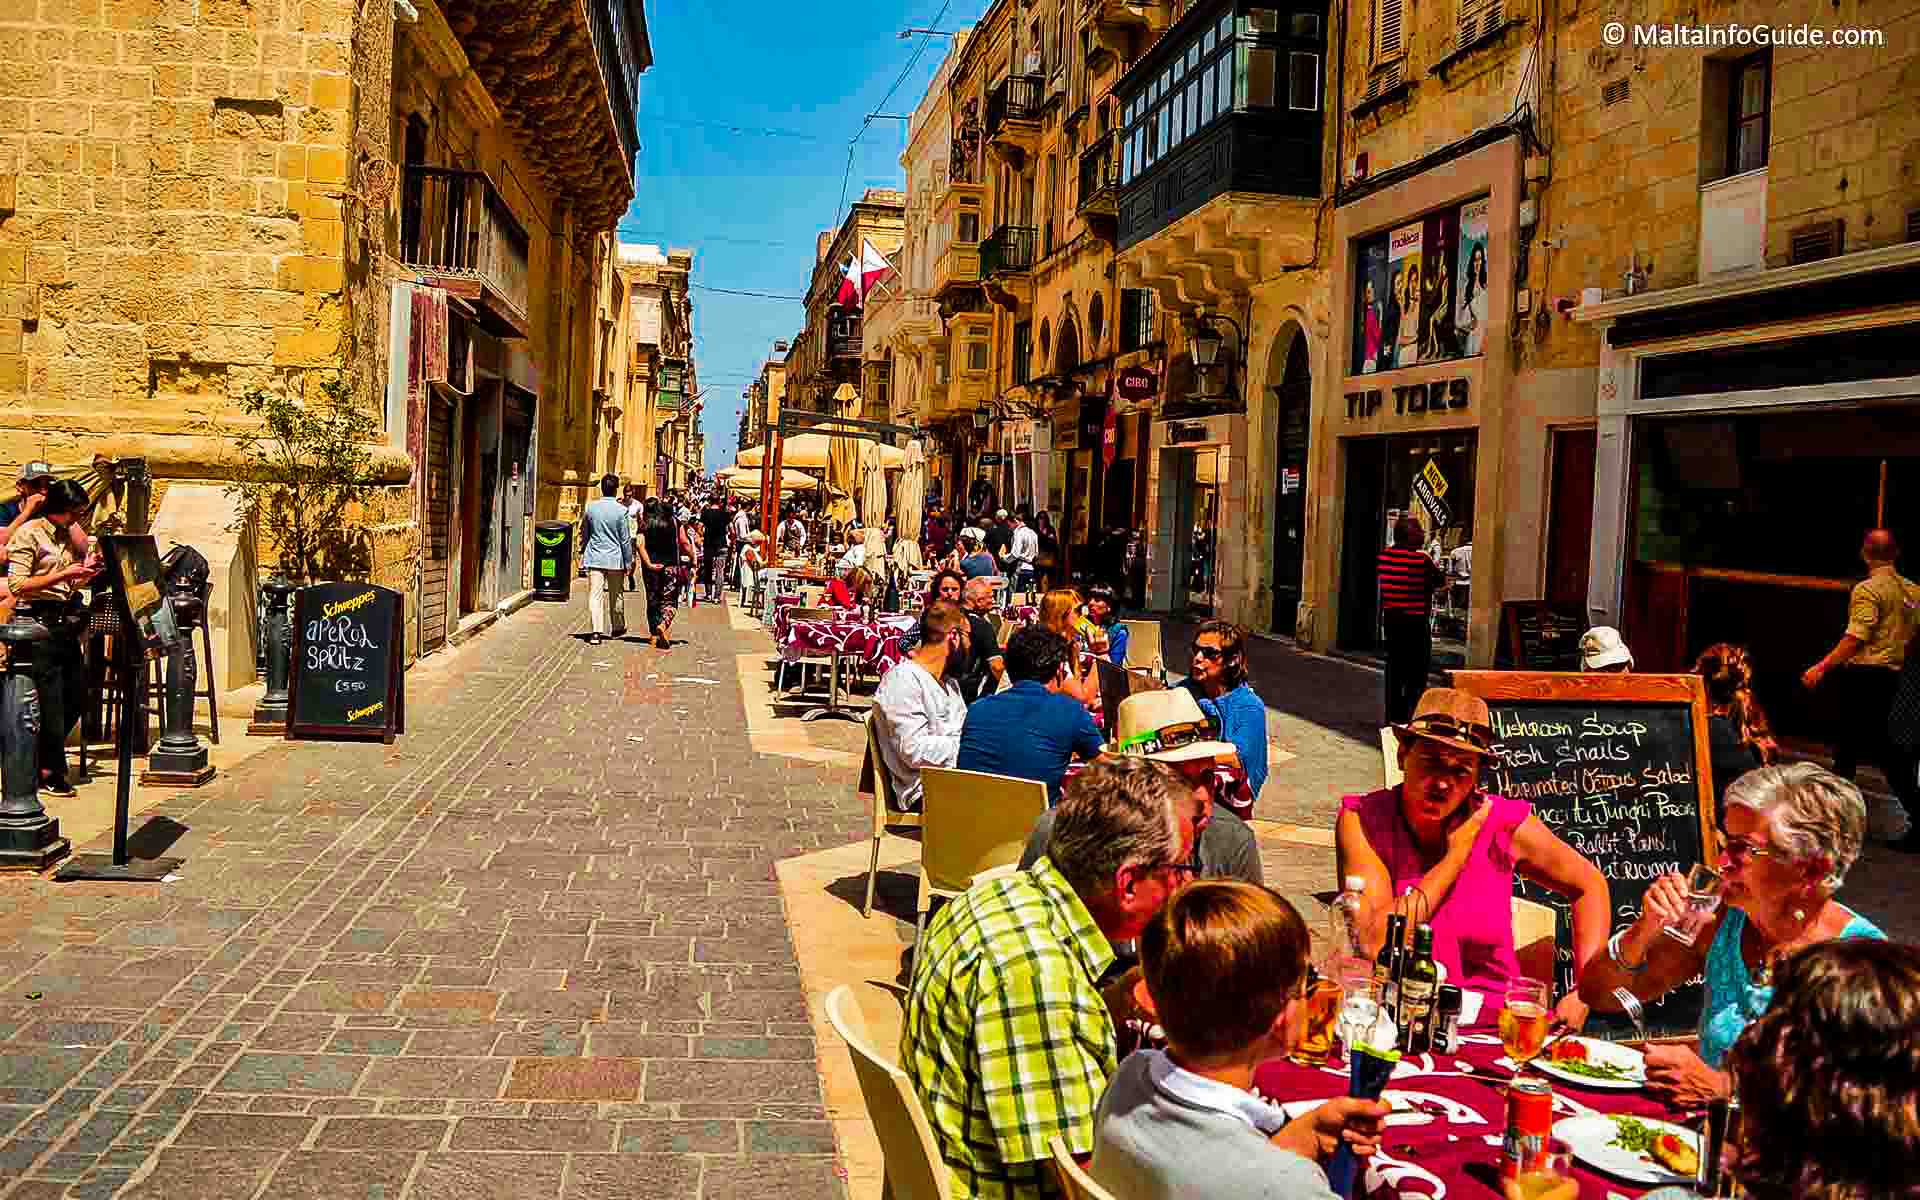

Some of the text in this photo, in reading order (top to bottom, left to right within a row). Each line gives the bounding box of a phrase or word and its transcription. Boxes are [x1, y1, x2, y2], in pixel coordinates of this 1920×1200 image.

[1125, 376, 1149, 389] CIBO
[1344, 376, 1469, 419] TIP TOES
[1426, 464, 1446, 495] NEW
[1416, 480, 1448, 527] ARRIVALS
[322, 591, 376, 620] Schweppes
[346, 700, 384, 723] Schweppes
[1580, 711, 1648, 747] Soup
[1555, 740, 1631, 768] Snails
[1640, 760, 1690, 790] Salad
